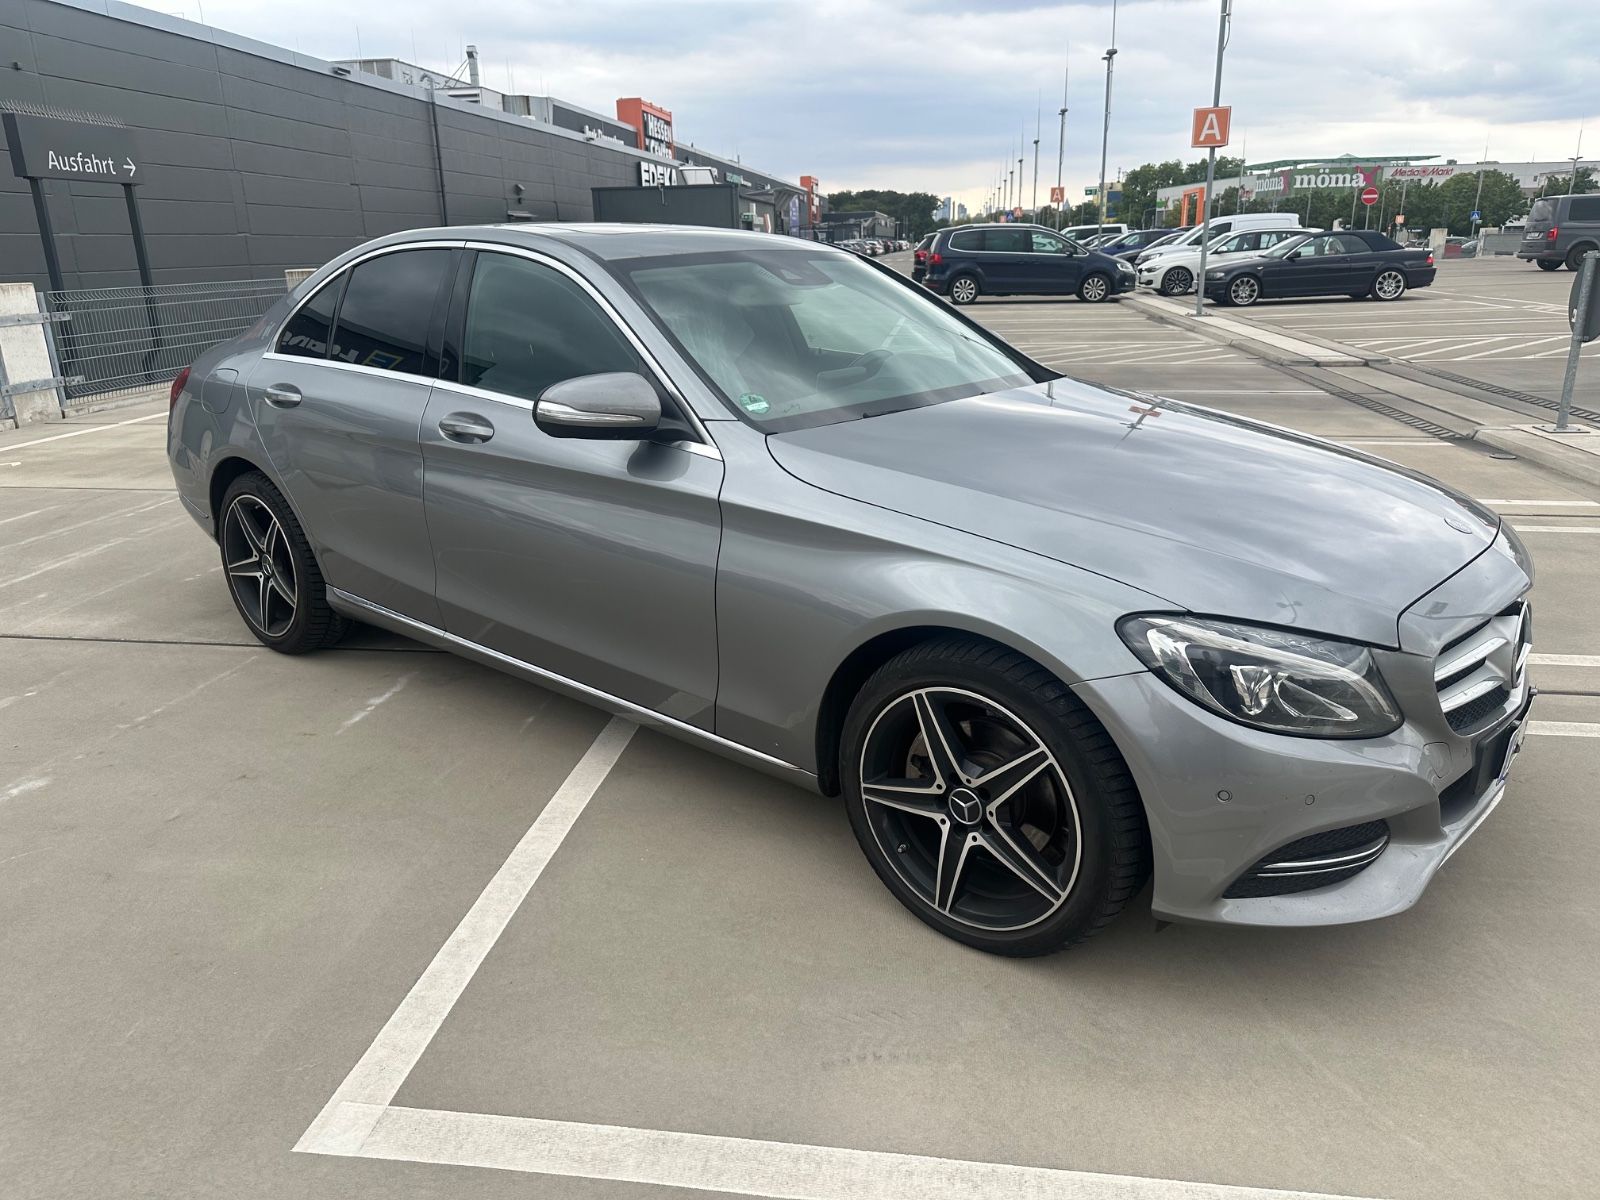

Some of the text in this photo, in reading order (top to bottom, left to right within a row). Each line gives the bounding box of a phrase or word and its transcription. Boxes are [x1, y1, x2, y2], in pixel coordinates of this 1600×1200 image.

[1199, 113, 1221, 141] A
[48, 150, 117, 175] Ausfahrt
[640, 161, 677, 187] EDEKA
[1053, 189, 1061, 201] A
